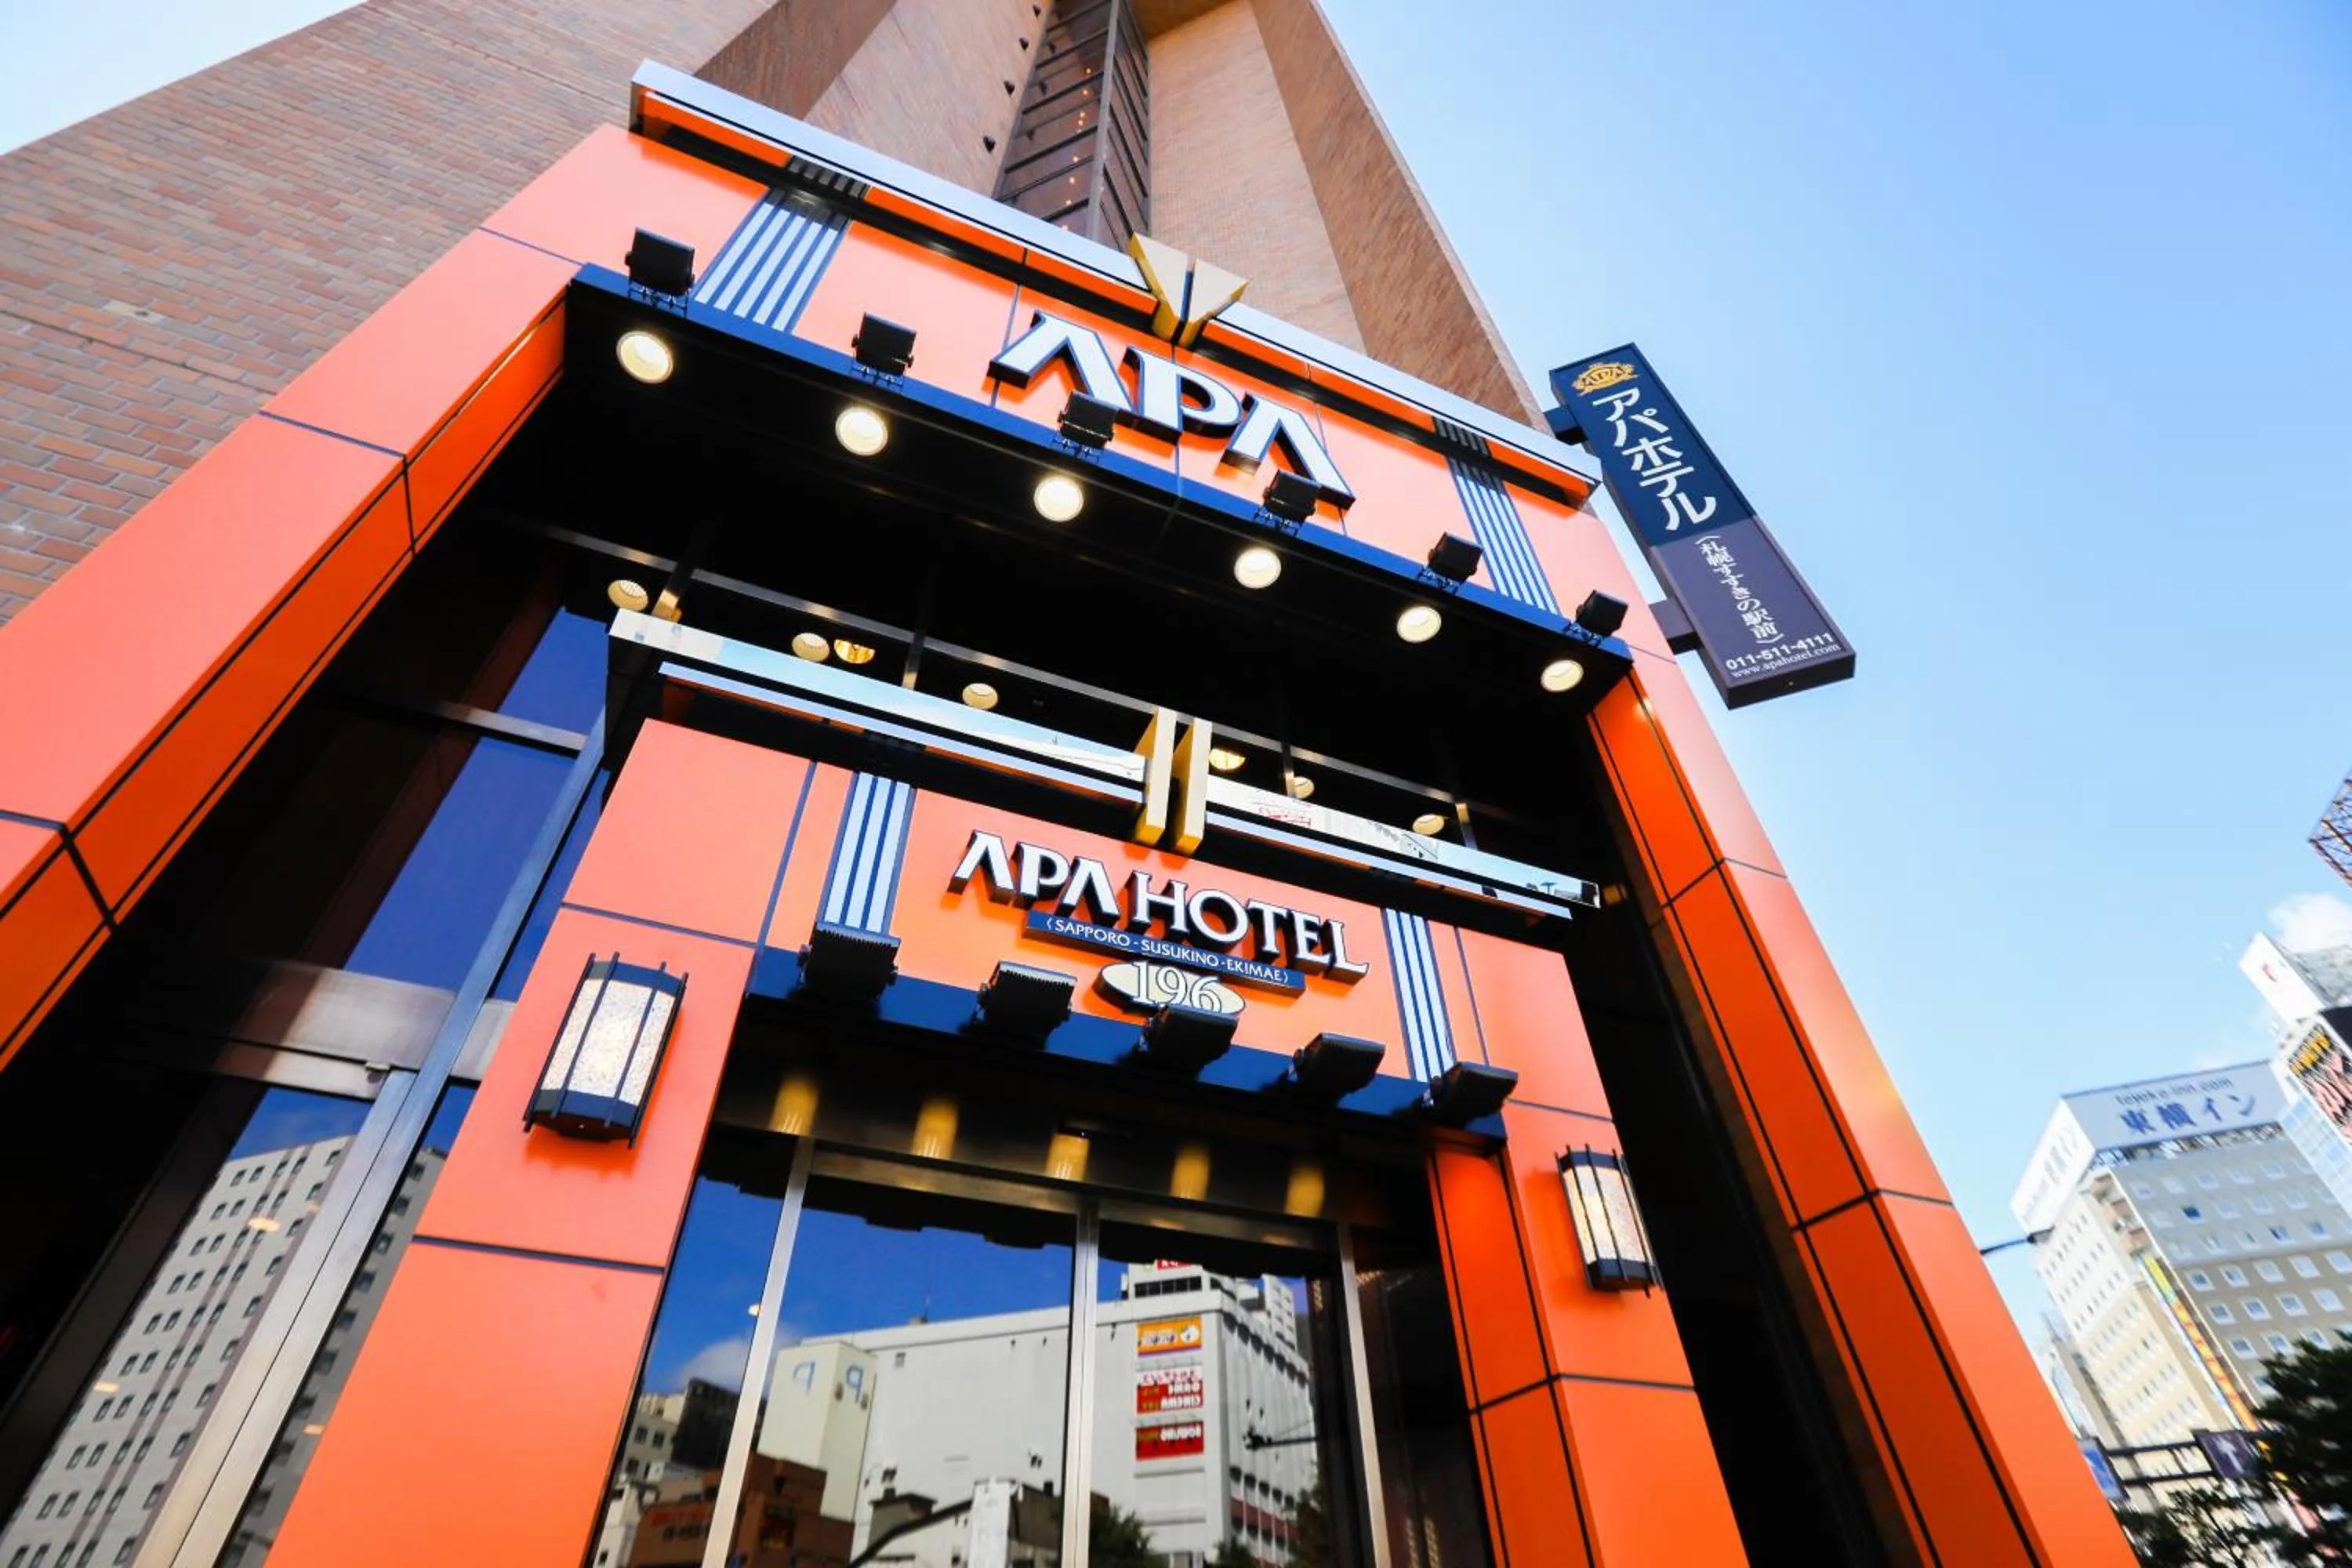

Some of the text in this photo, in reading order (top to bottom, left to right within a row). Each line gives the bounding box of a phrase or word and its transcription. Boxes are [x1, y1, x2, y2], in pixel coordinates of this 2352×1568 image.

[987, 310, 1355, 503] APA
[1592, 387, 1716, 532] アパホテル
[1726, 632, 1834, 670] 011-511-4111
[1731, 643, 1842, 679] www.apahotel.com
[950, 829, 1370, 978] APA HOTEL
[1131, 960, 1223, 1013] 196
